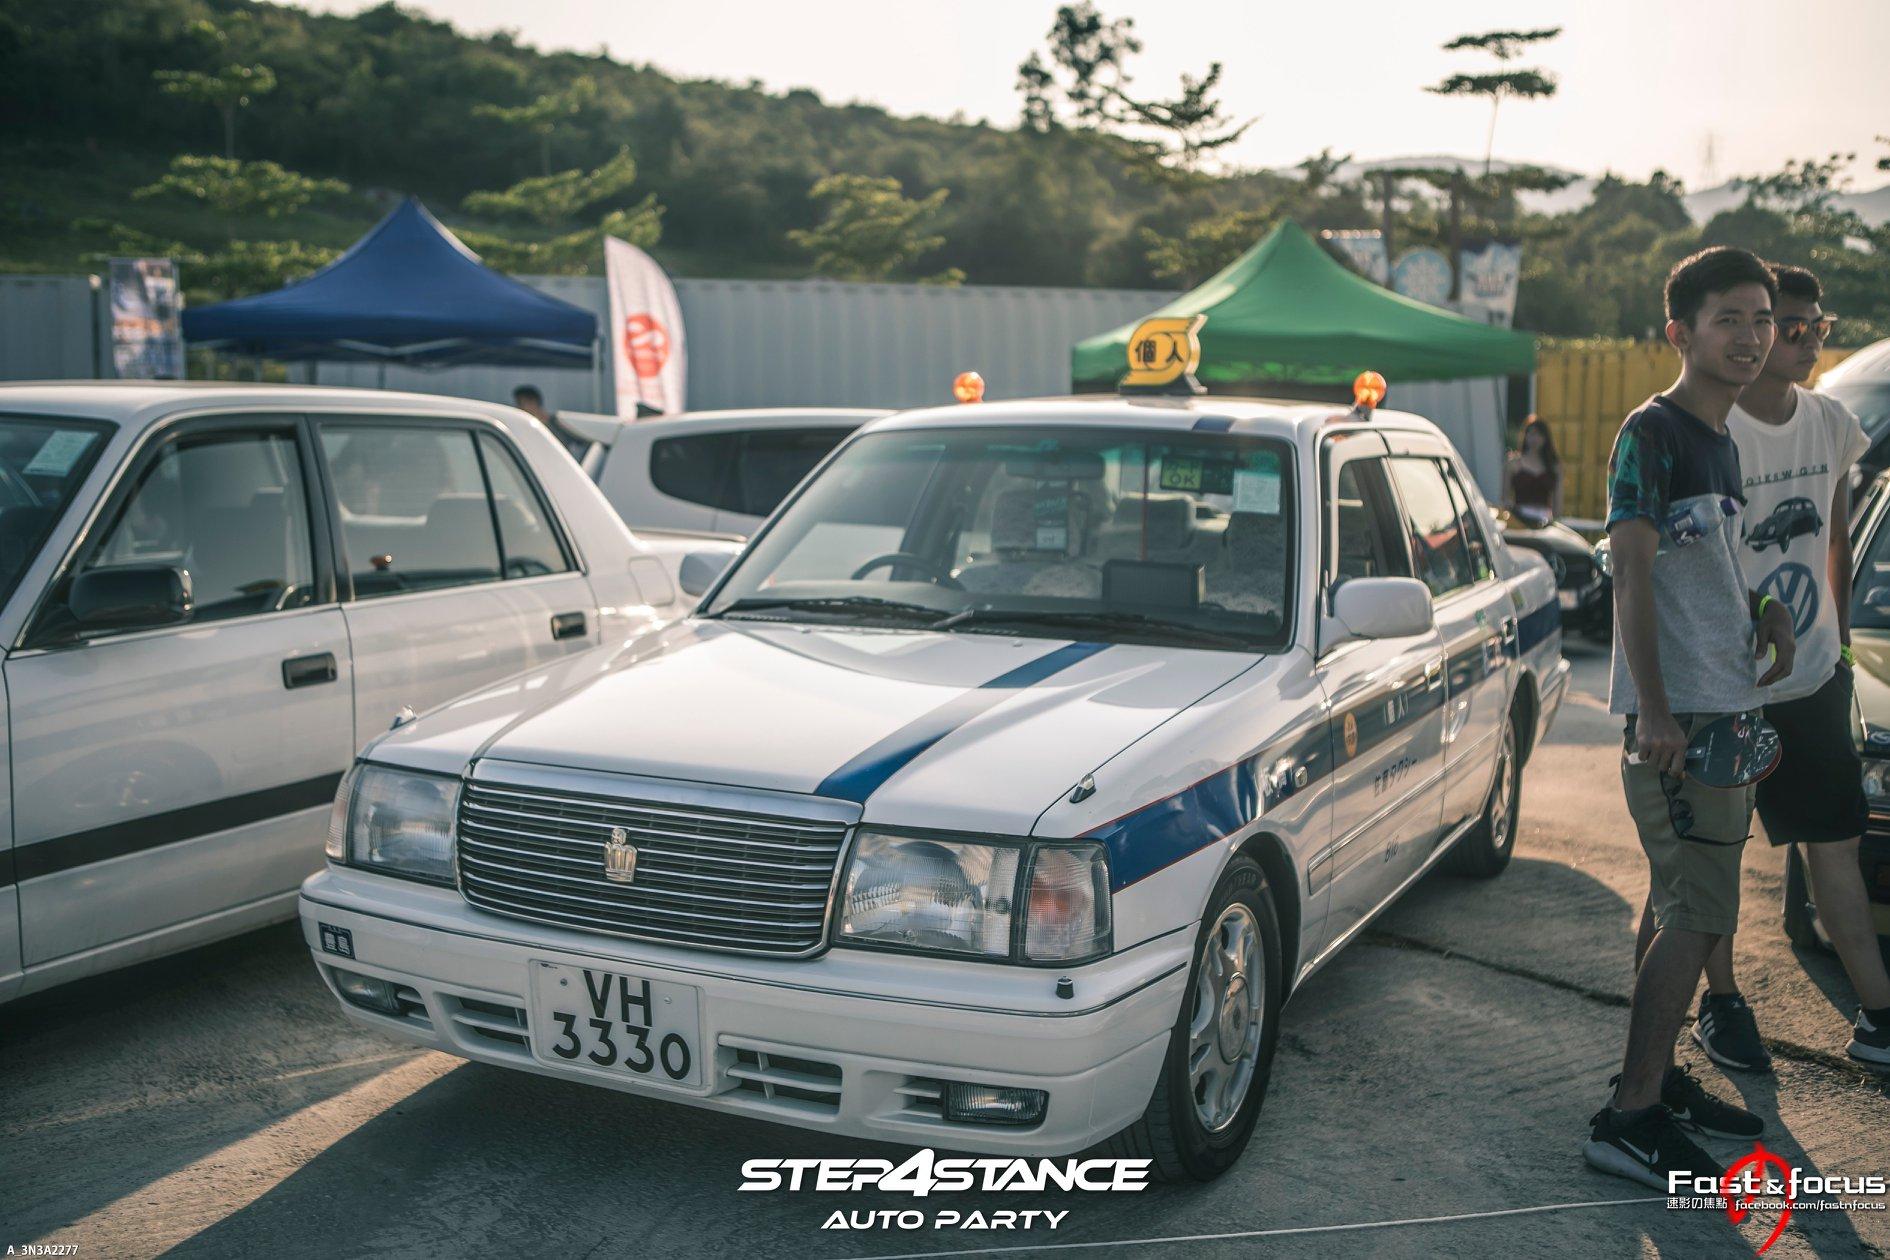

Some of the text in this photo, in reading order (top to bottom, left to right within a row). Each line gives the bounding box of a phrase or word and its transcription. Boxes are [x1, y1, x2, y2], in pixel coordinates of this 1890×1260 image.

[1135, 339, 1184, 363] 個人
[1169, 473, 1197, 486] OK
[583, 969, 653, 1028] VH
[552, 1011, 692, 1081] 3330
